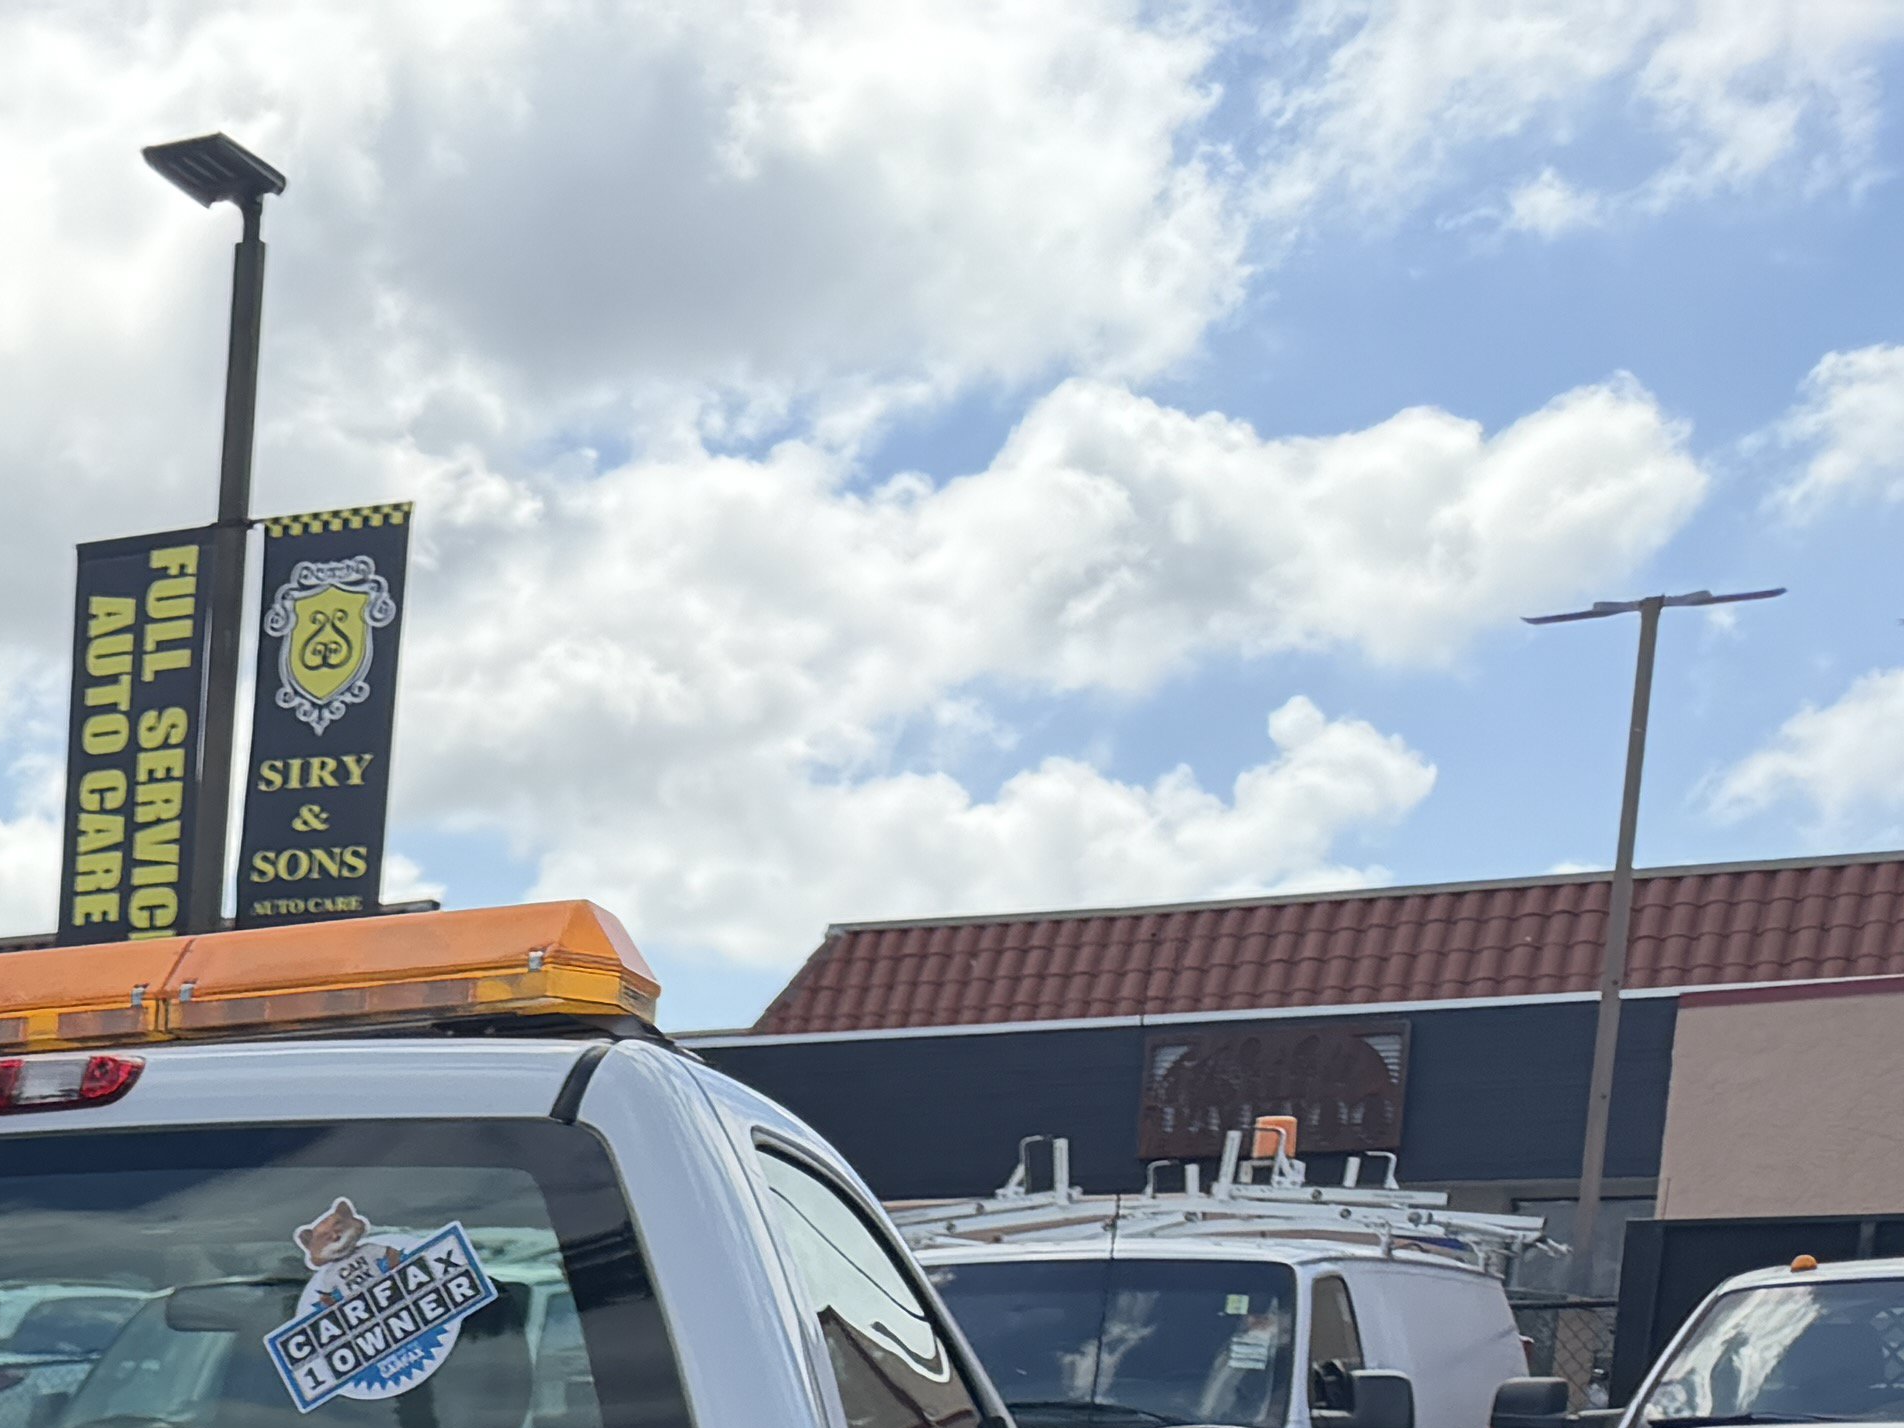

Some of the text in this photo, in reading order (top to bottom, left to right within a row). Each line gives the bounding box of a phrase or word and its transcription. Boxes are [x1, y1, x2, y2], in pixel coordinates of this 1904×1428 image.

[72, 595, 136, 926] AUTO CARE
[128, 544, 199, 940] FULL SERVIC
[257, 753, 373, 792] SIRY
[291, 803, 331, 832] &
[249, 846, 368, 884] SONS
[251, 897, 305, 915] AUTO
[289, 1250, 462, 1360] CARFAX
[332, 1275, 478, 1373] OWNER
